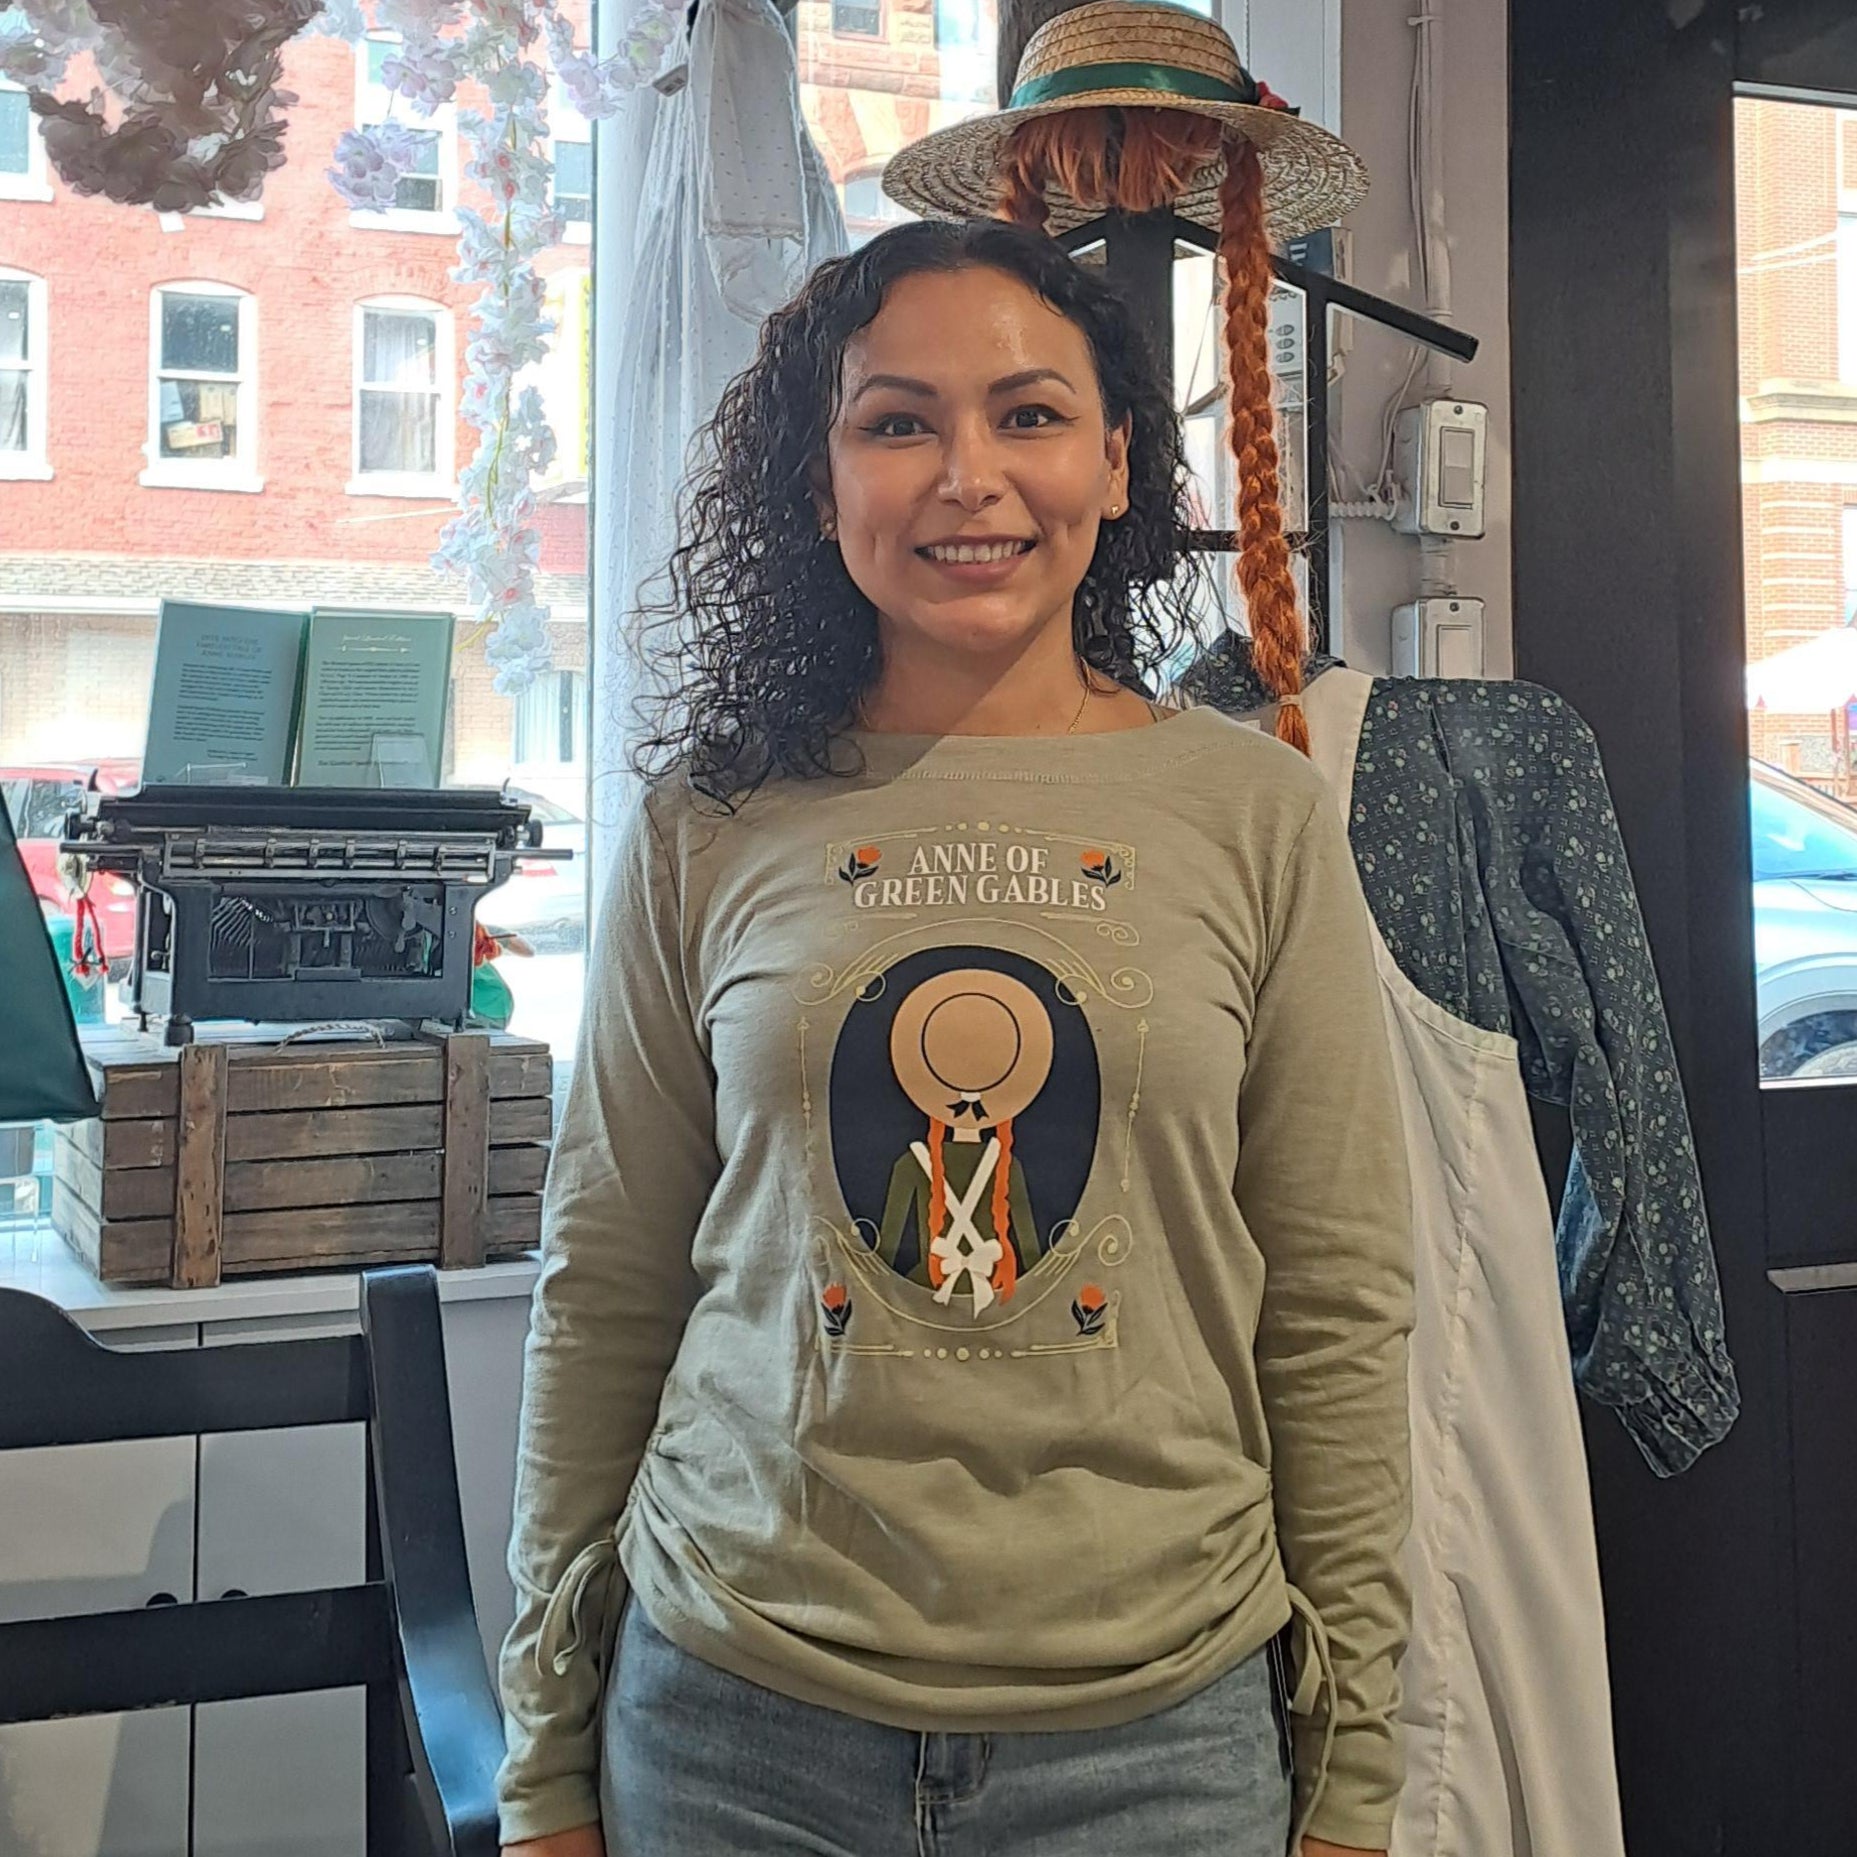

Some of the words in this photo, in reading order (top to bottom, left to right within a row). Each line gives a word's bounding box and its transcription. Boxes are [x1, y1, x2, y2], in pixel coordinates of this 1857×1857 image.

[908, 843, 997, 876] ANNE
[1006, 846, 1049, 875] OF
[854, 875, 967, 909] GREEN
[976, 874, 1106, 911] GABLES
